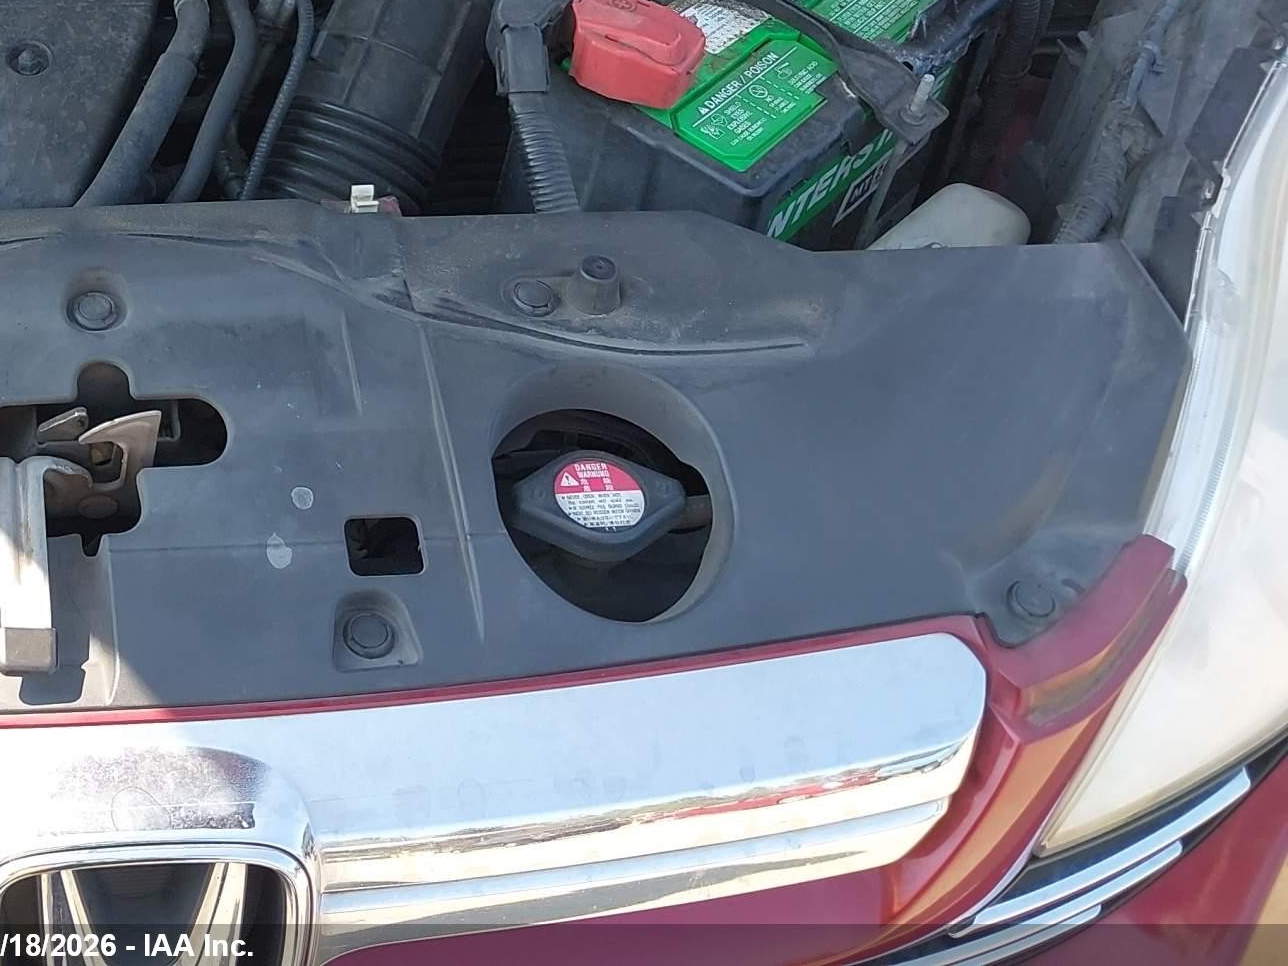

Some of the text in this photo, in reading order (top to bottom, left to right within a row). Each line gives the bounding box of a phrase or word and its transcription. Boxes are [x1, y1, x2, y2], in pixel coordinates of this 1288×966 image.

[704, 76, 742, 111] DANGER
[744, 52, 780, 79] POISON
[574, 463, 608, 471] DANGER
